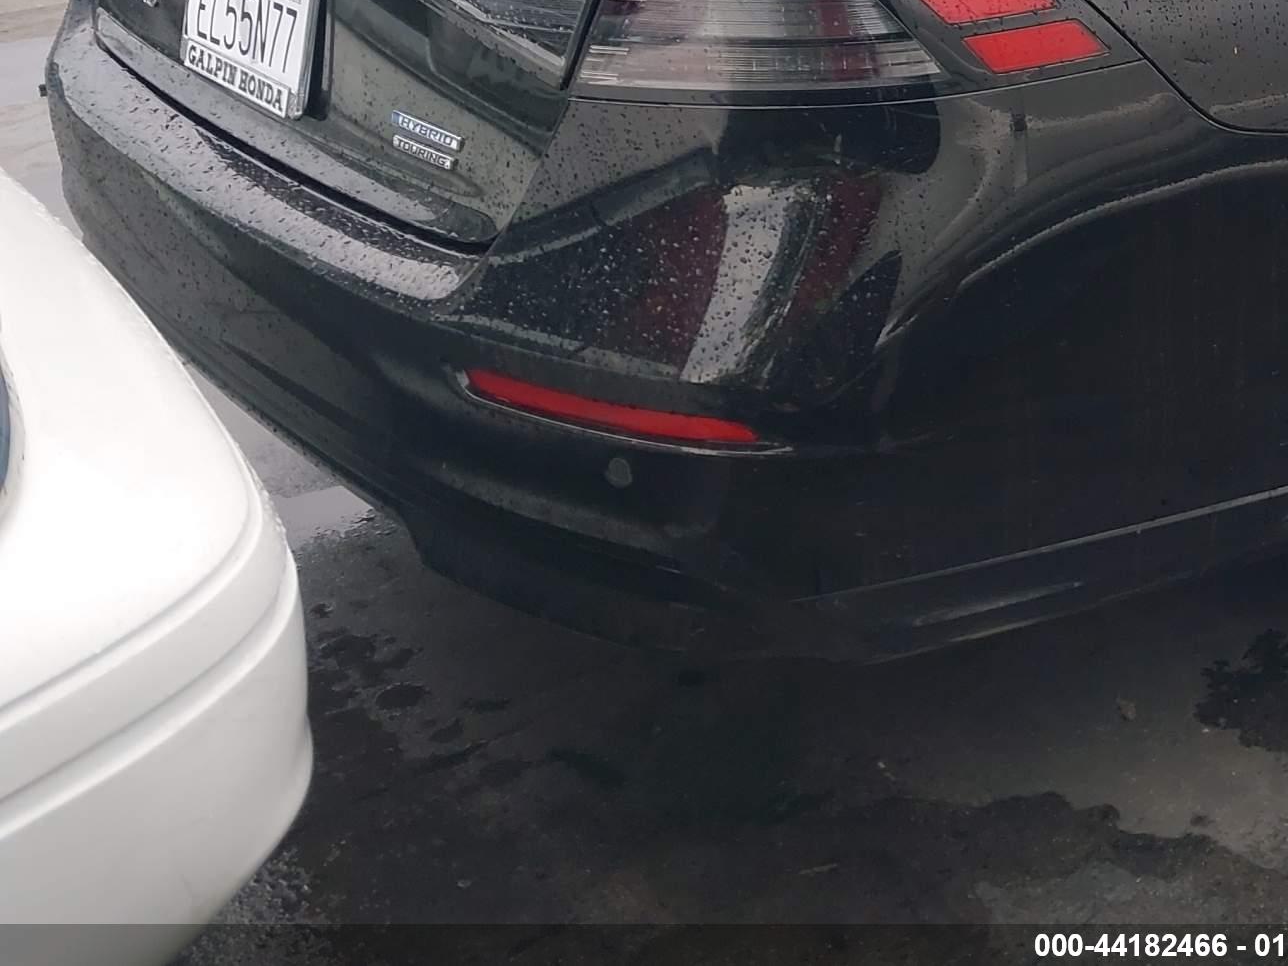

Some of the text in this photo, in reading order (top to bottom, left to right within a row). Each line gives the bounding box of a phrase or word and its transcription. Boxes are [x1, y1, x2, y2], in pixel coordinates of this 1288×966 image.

[187, 44, 284, 112] GALPIN HONDA
[400, 116, 453, 146] HYBRID
[397, 139, 447, 166] TOURING
